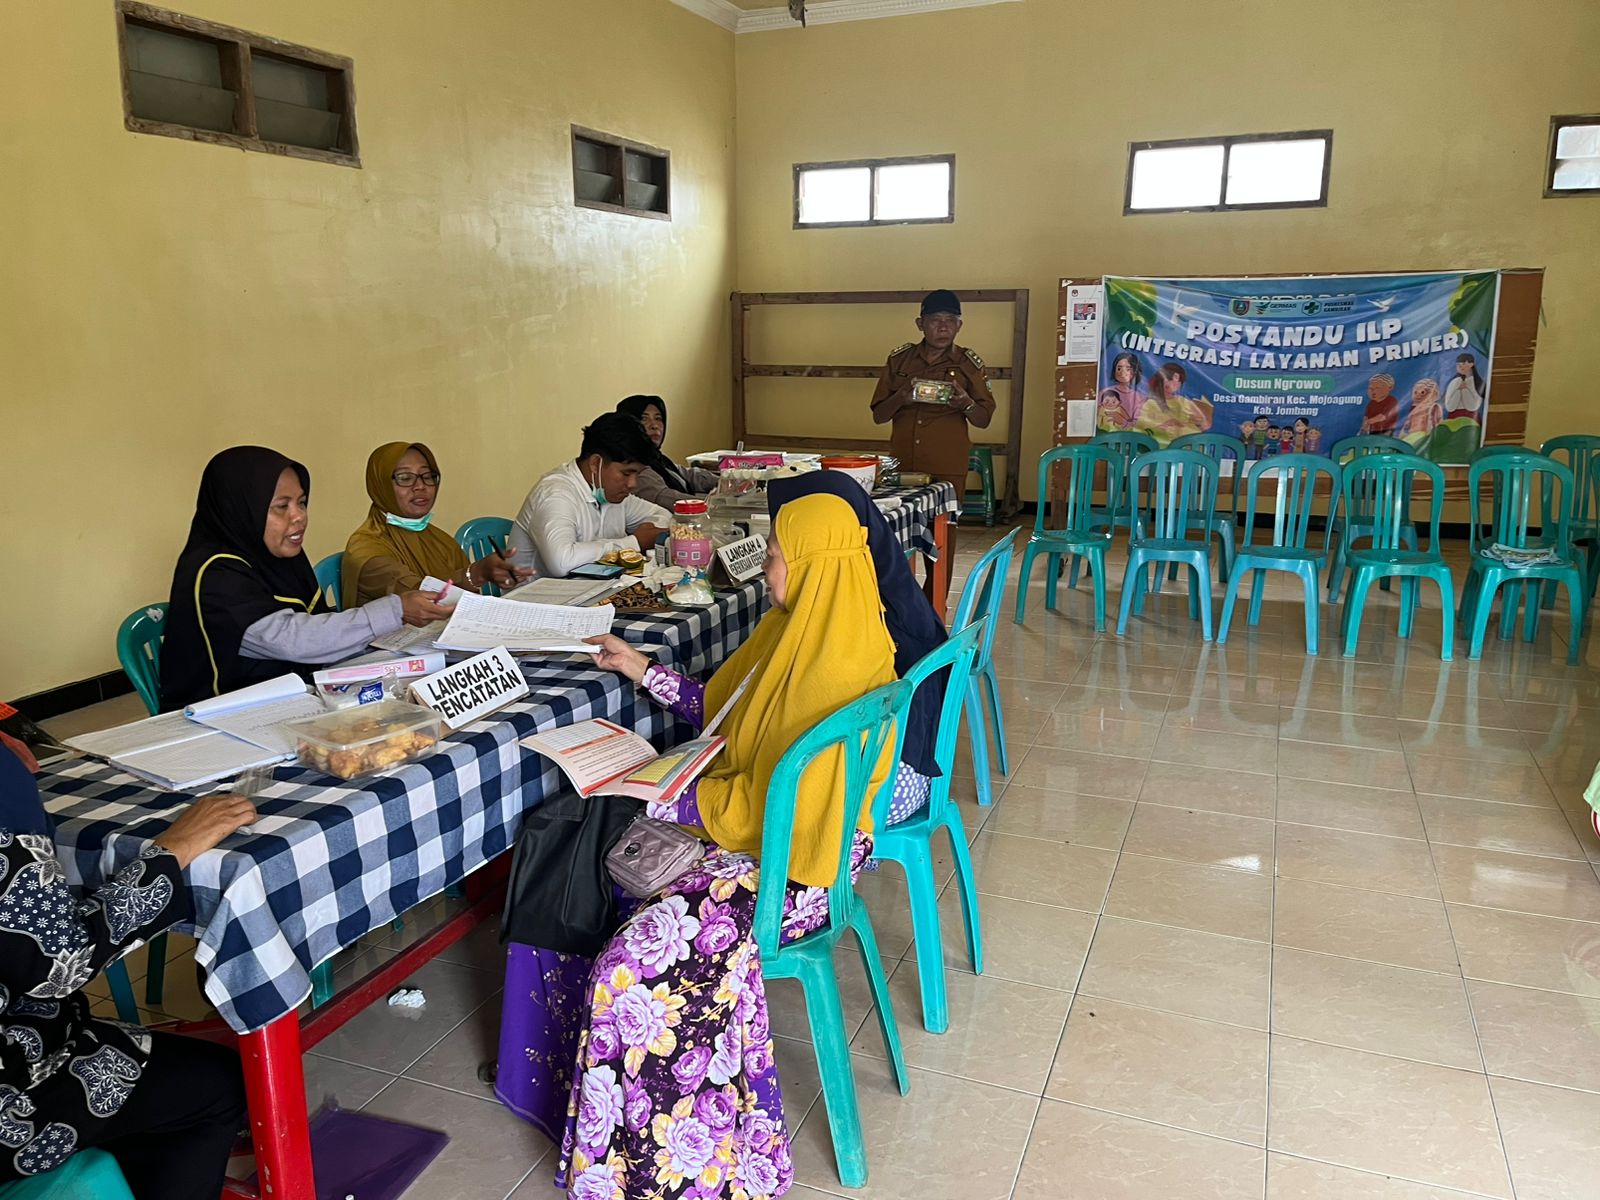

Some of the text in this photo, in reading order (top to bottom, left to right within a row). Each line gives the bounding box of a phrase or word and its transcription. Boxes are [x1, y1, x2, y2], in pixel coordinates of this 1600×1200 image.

[1186, 318, 1402, 348] POSYANDU ILP
[1121, 328, 1470, 370] (INTEGRASI LAYANAN PRIMER)
[1235, 377, 1322, 391] Dusun Ngrowo
[1213, 393, 1363, 406] Desa Gambiran Kec. Mojoagung
[1253, 406, 1319, 417] Kab. Jombang
[725, 538, 762, 562] LANGKAH 4
[427, 655, 504, 702] LANGKAH 3
[432, 669, 522, 720] PENCATATAN
